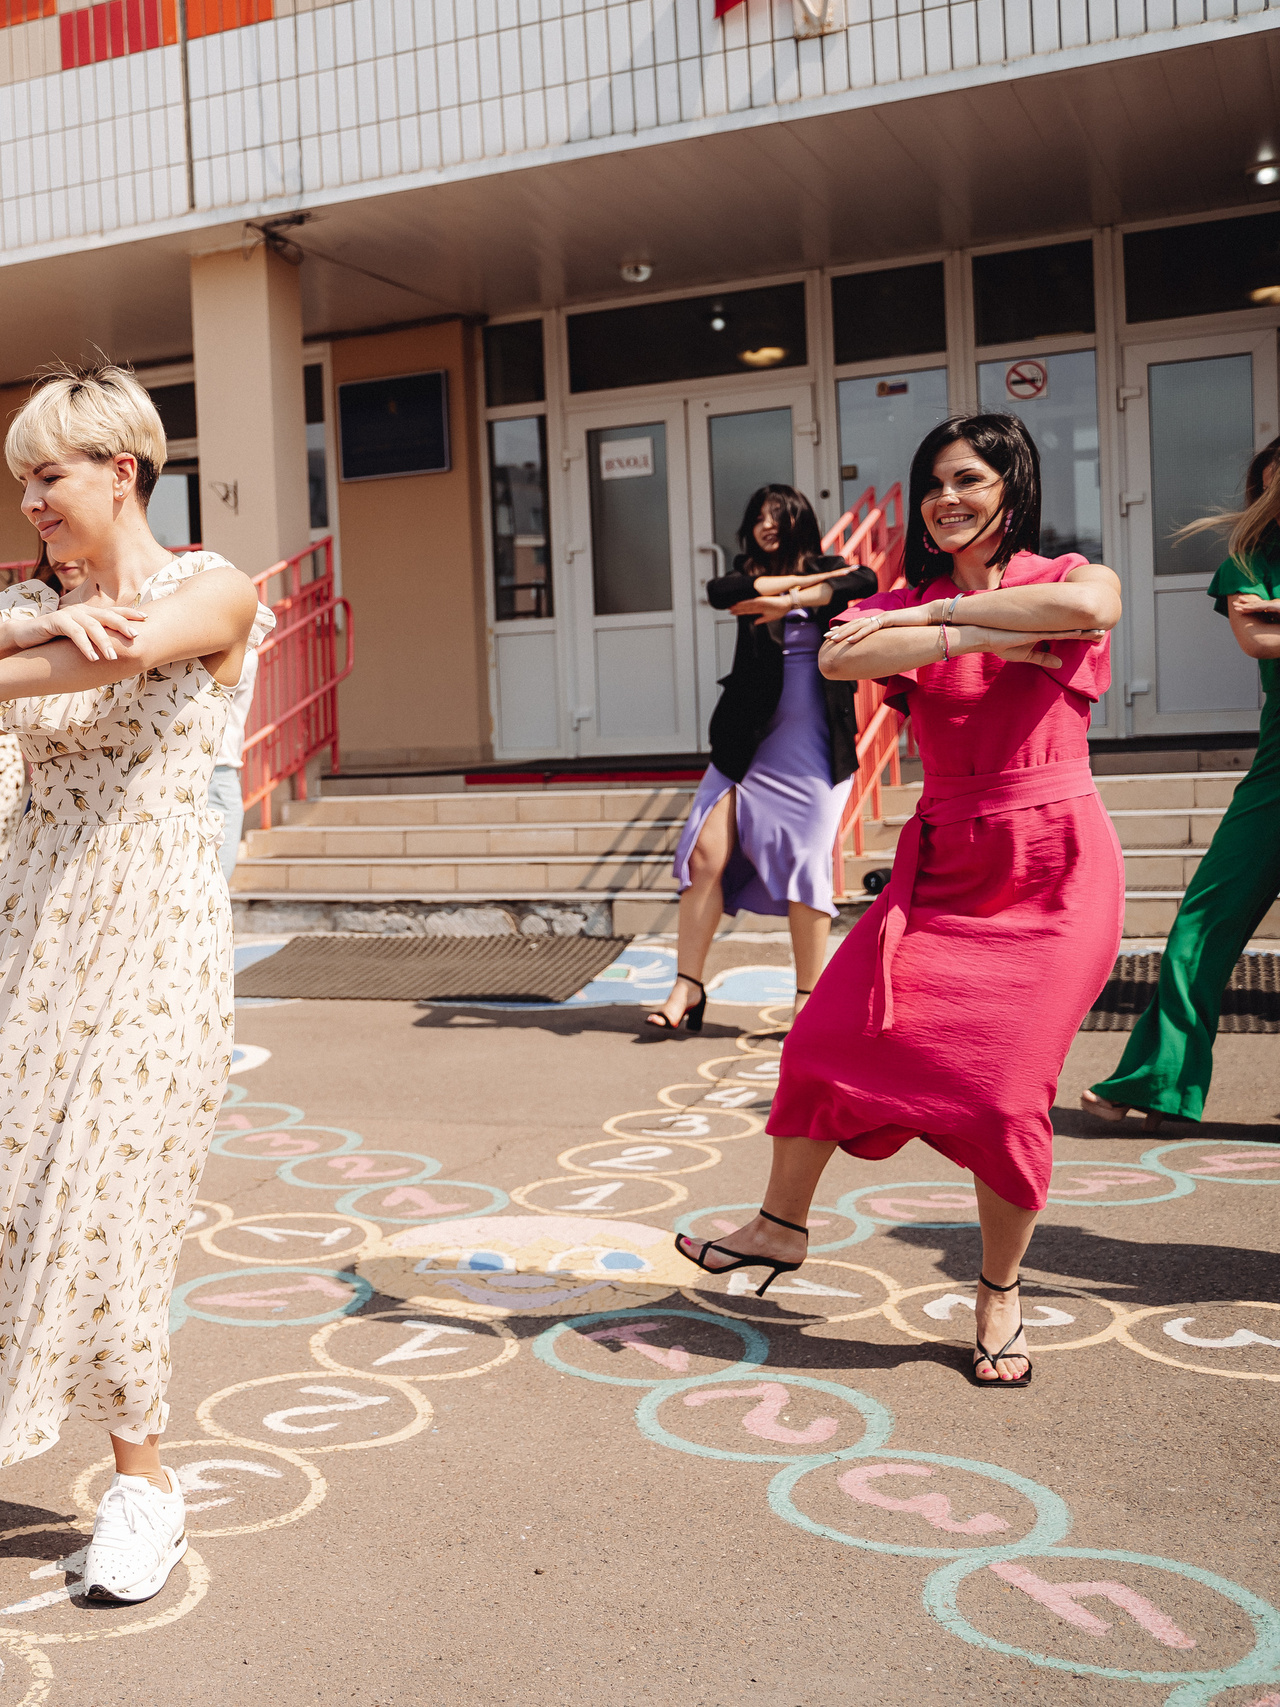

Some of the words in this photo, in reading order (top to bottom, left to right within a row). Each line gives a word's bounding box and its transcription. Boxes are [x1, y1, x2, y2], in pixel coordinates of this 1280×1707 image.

[604, 453, 650, 473] ВХОД
[703, 1086, 759, 1108] 4
[640, 1113, 711, 1137] 3
[244, 1131, 321, 1157] 3
[589, 1144, 673, 1171] 2
[326, 1155, 412, 1180] 2
[380, 1185, 471, 1217] 1
[554, 1181, 625, 1211] 1
[236, 1225, 353, 1247] 1
[188, 1275, 357, 1308] 1
[726, 1271, 863, 1299] 1
[371, 1319, 477, 1367] 1
[578, 1322, 692, 1373] 1
[261, 1384, 391, 1435] 2
[682, 1381, 839, 1445] 2
[837, 1463, 1011, 1536] 3
[987, 1561, 1198, 1651] 4
